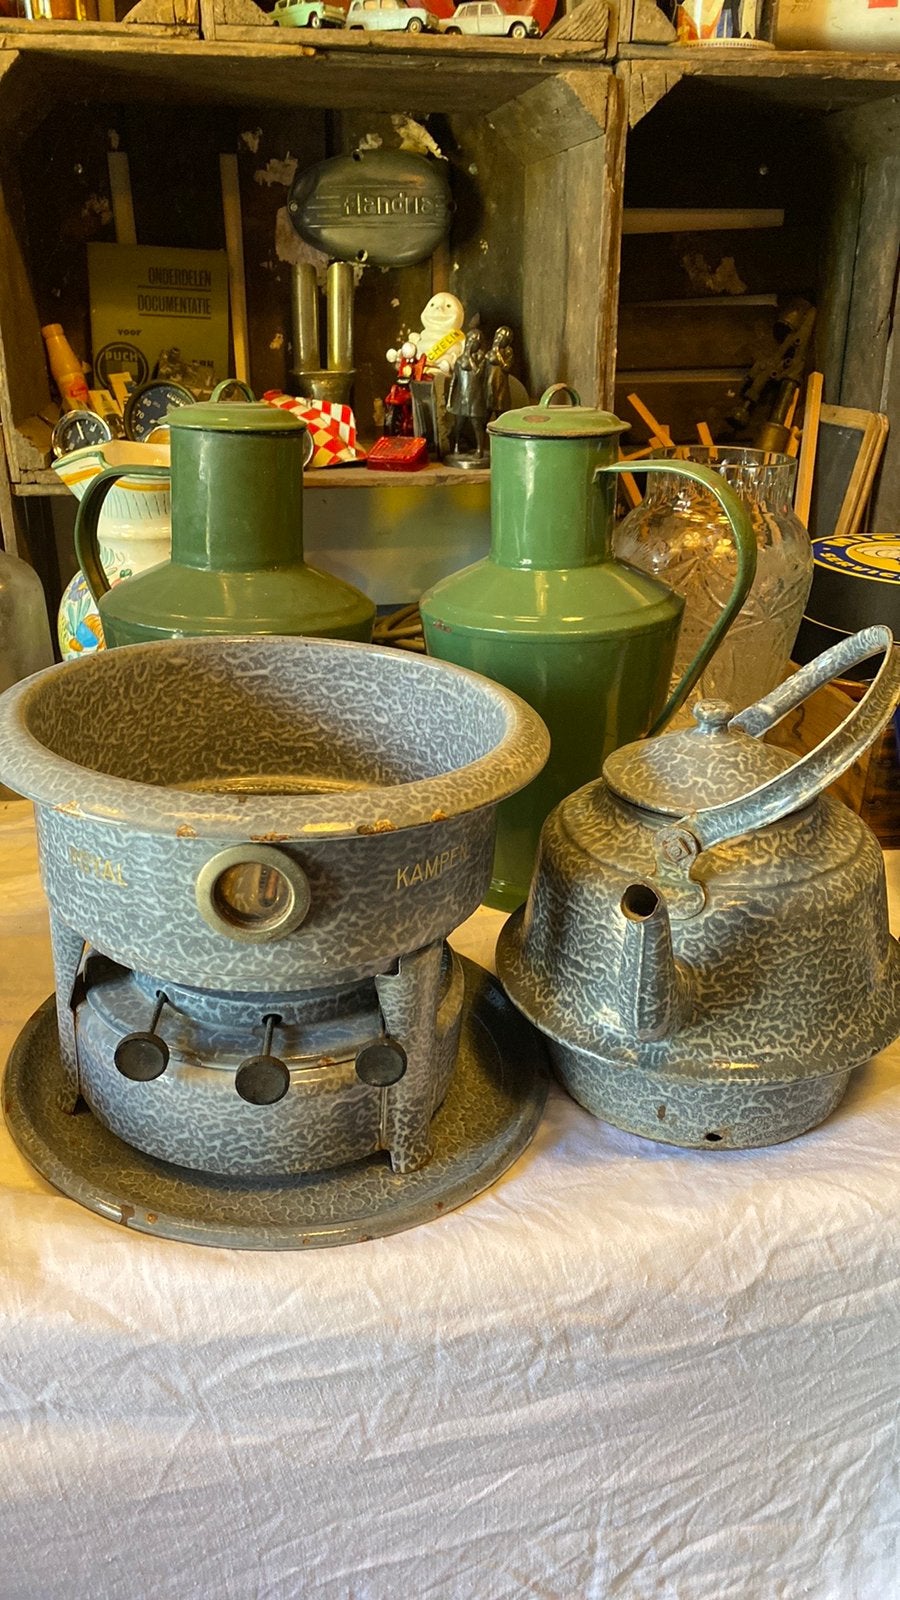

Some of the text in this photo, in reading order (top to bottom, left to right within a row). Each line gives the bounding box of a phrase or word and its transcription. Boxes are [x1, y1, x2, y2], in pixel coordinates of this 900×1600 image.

[148, 266, 212, 287] ONDERDELEN
[137, 294, 212, 315] DOCUMENTATIE
[105, 350, 138, 363] PUCH
[135, 409, 145, 419] 70
[396, 842, 471, 890] KAMPEN
